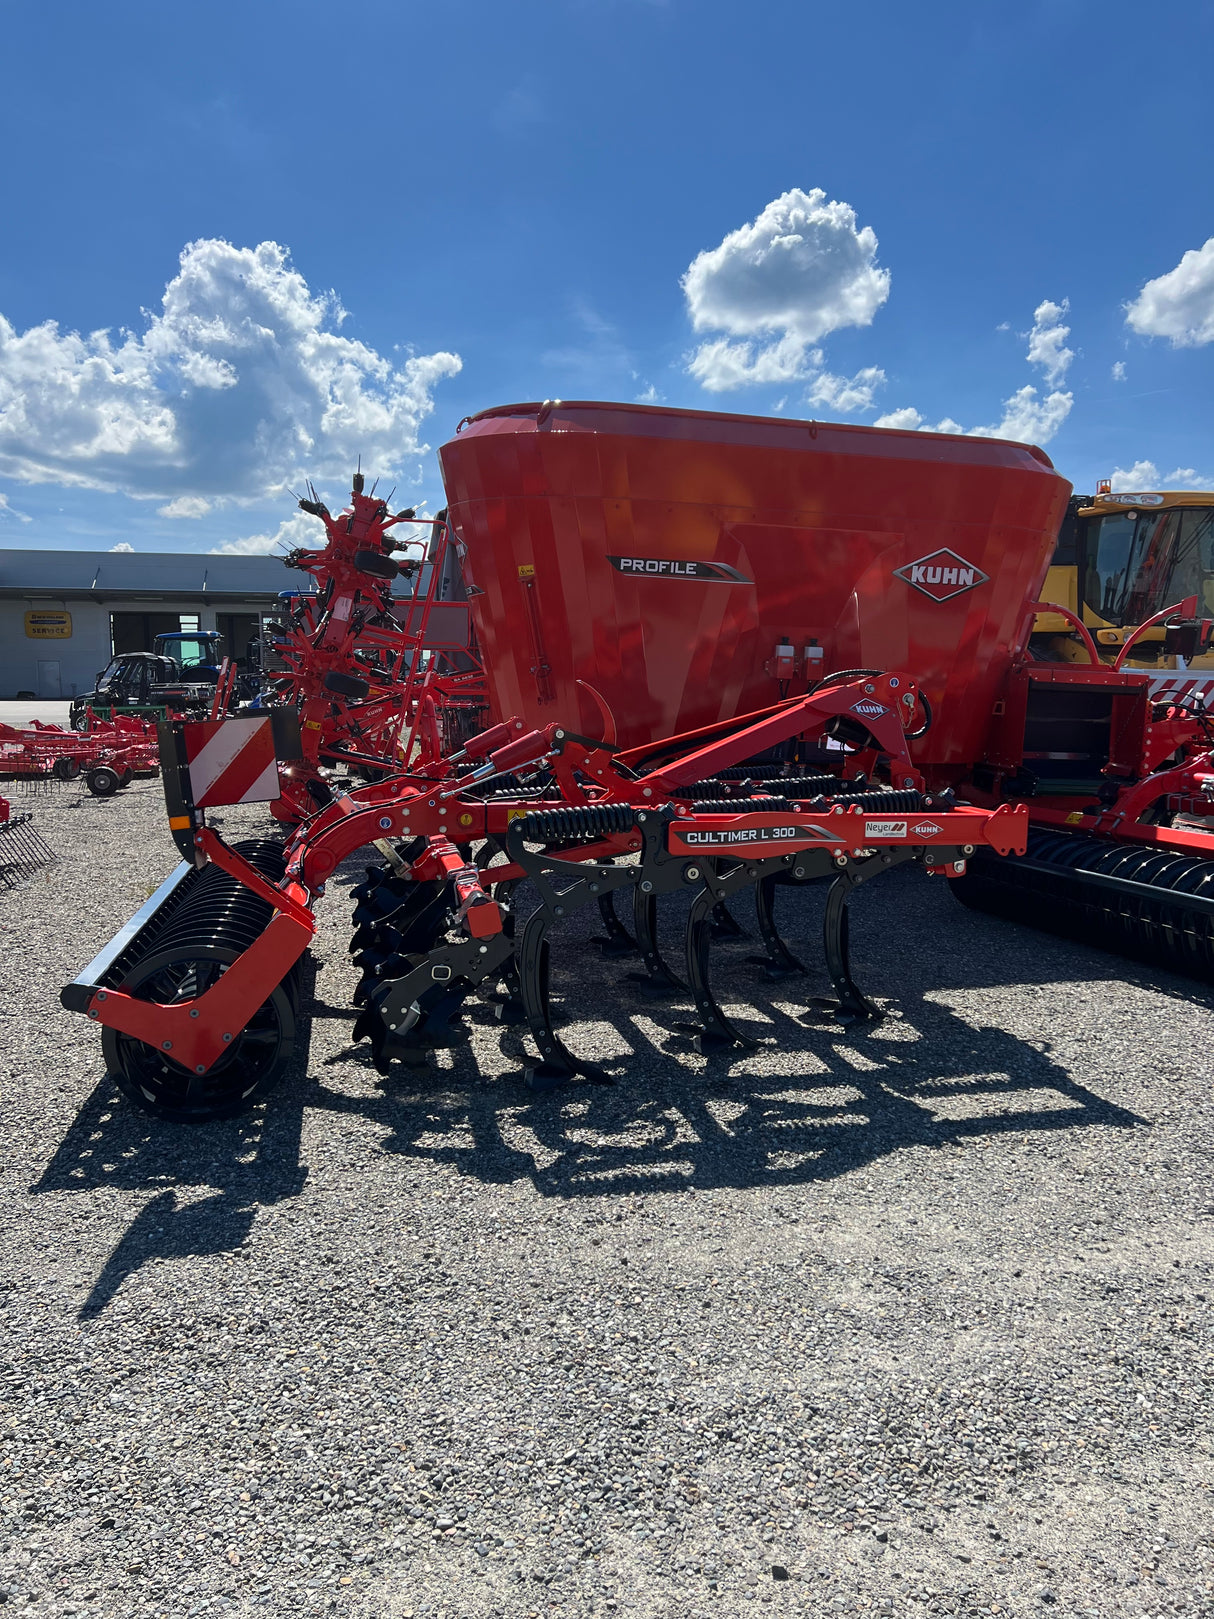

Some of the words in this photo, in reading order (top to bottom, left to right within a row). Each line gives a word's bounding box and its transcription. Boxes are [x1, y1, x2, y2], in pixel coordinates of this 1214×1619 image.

[620, 558, 697, 575] PROFILE
[911, 565, 975, 586] KUHN
[366, 707, 383, 717] KUHN
[855, 705, 884, 713] KUHN
[866, 823, 892, 833] Neyer
[687, 829, 757, 843] CULTIMER
[761, 828, 769, 839] L
[772, 827, 796, 838] 300
